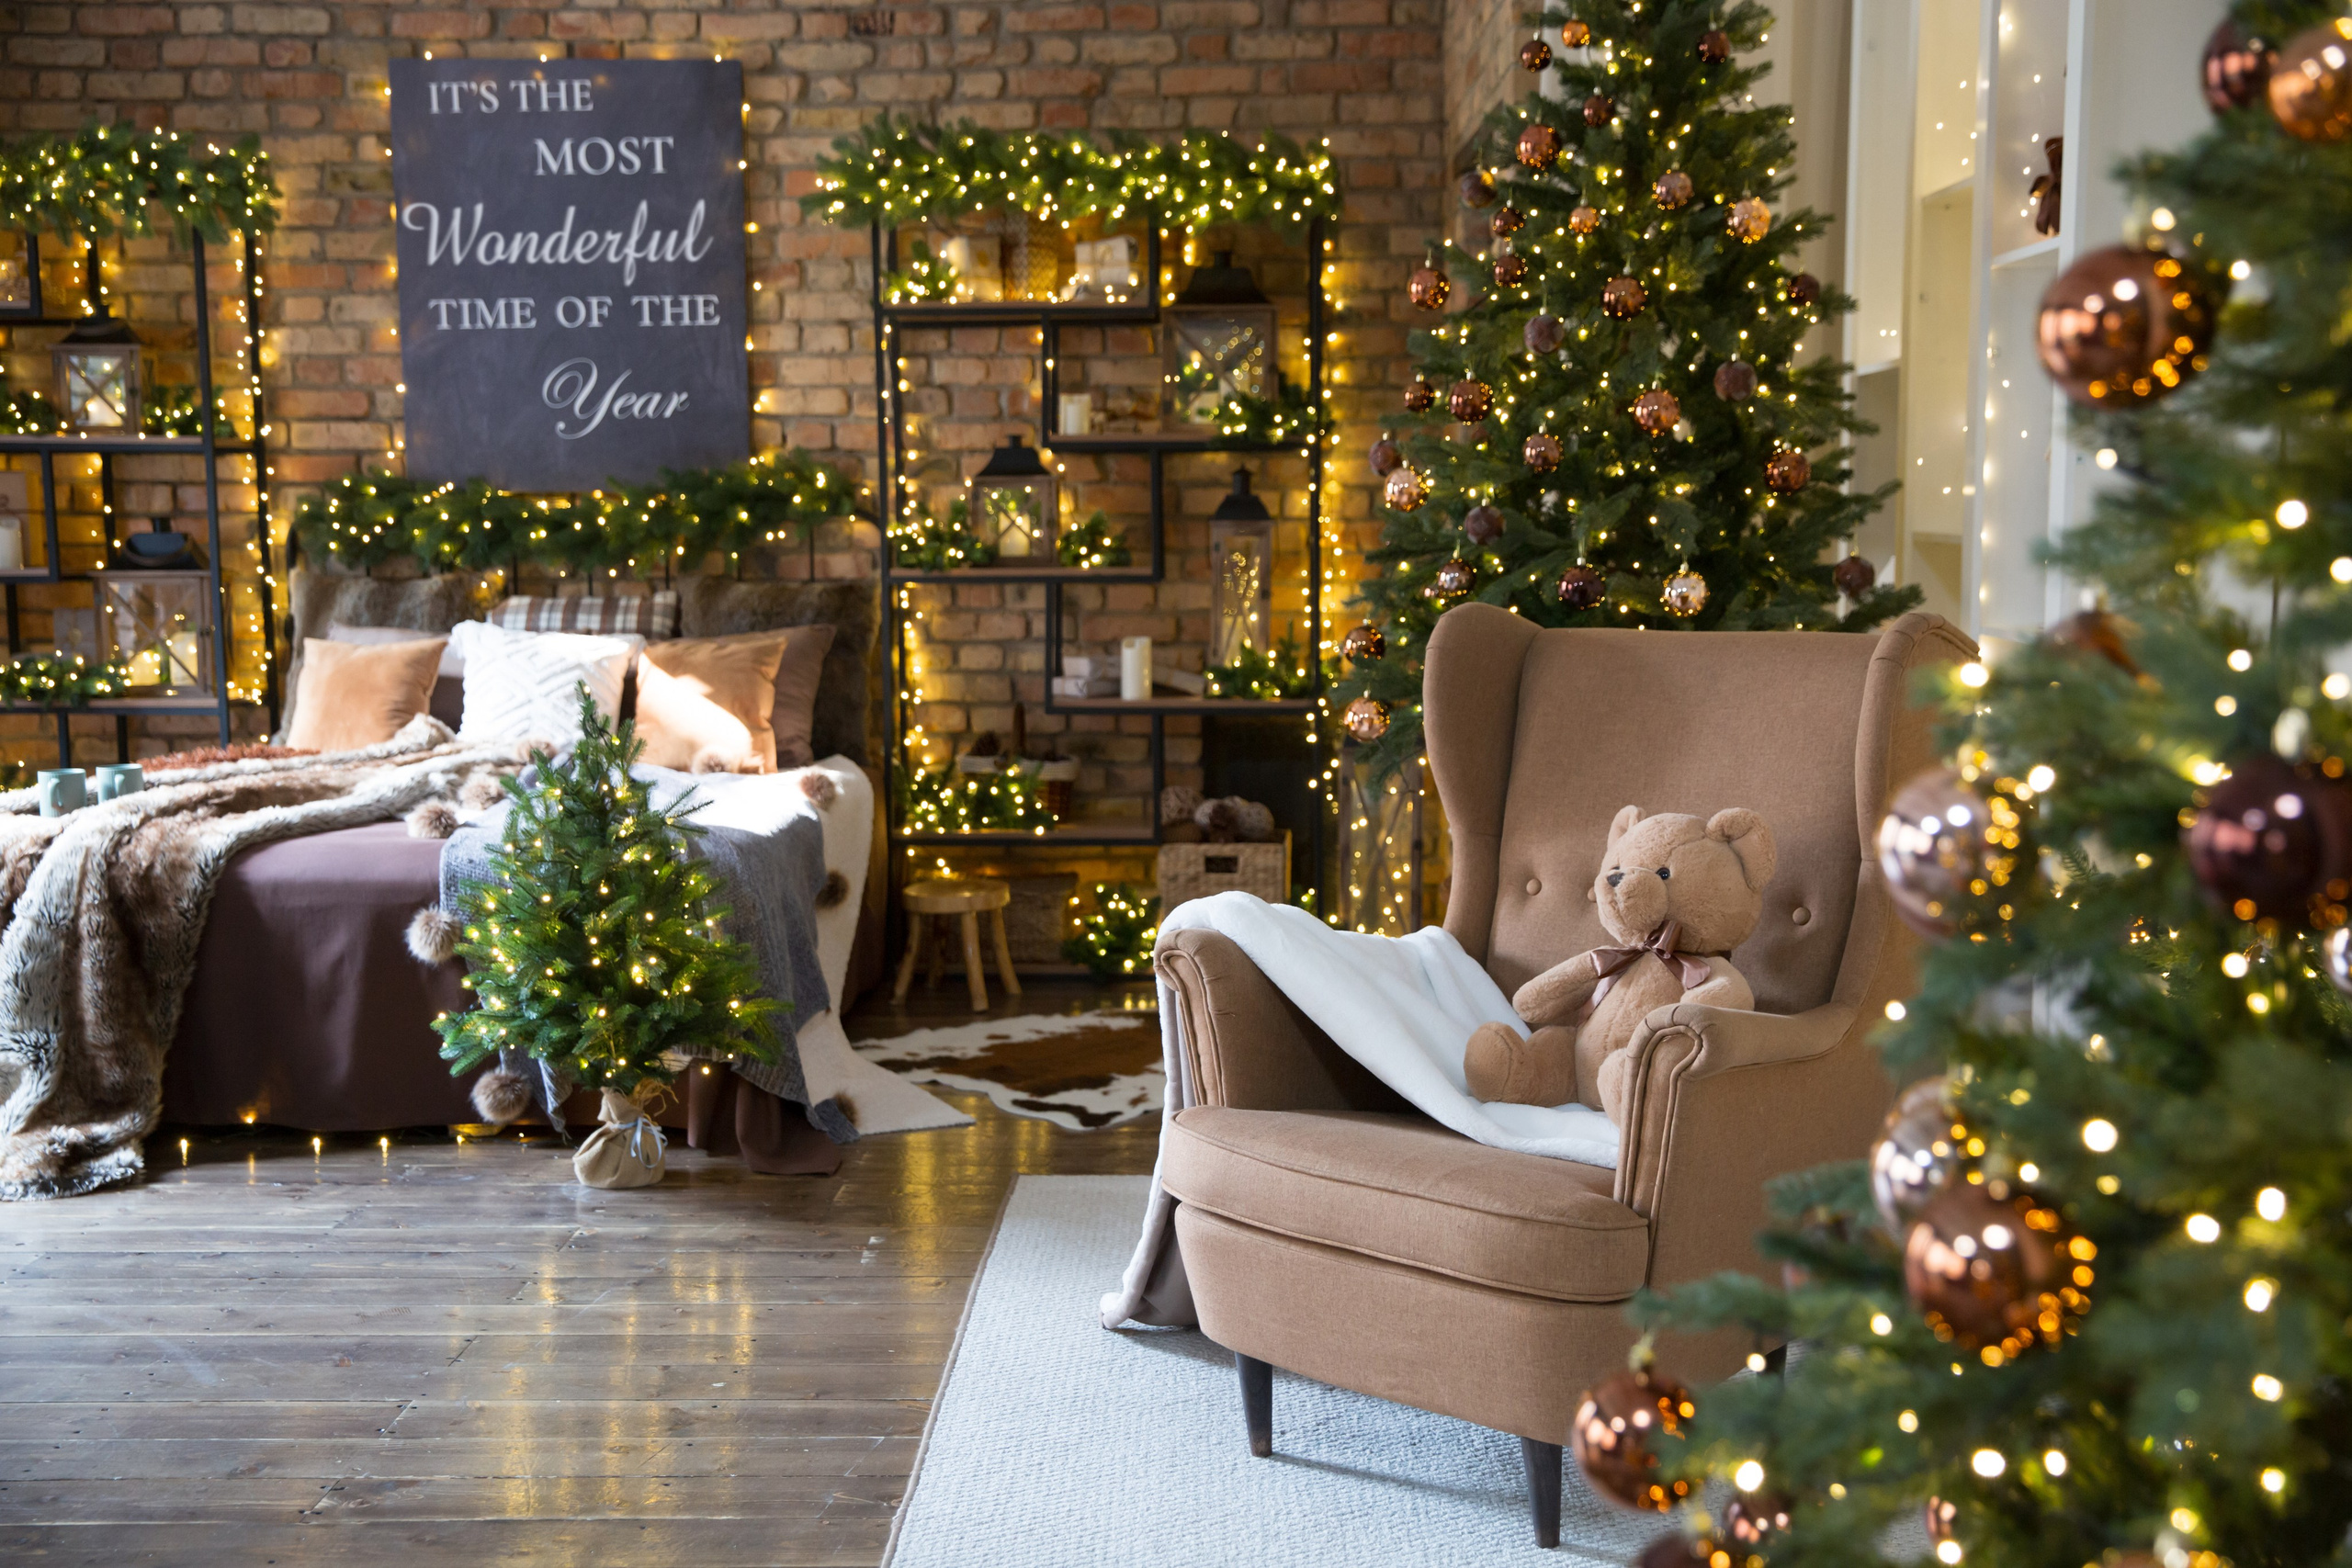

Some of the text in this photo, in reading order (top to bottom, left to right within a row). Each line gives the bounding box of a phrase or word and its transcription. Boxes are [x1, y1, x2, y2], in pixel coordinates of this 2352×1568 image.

[428, 79, 594, 114] IT'S THE
[535, 136, 674, 175] MOST
[401, 198, 714, 287] Wonderful
[428, 294, 721, 330] TIME OF THE
[542, 356, 690, 440] Year
